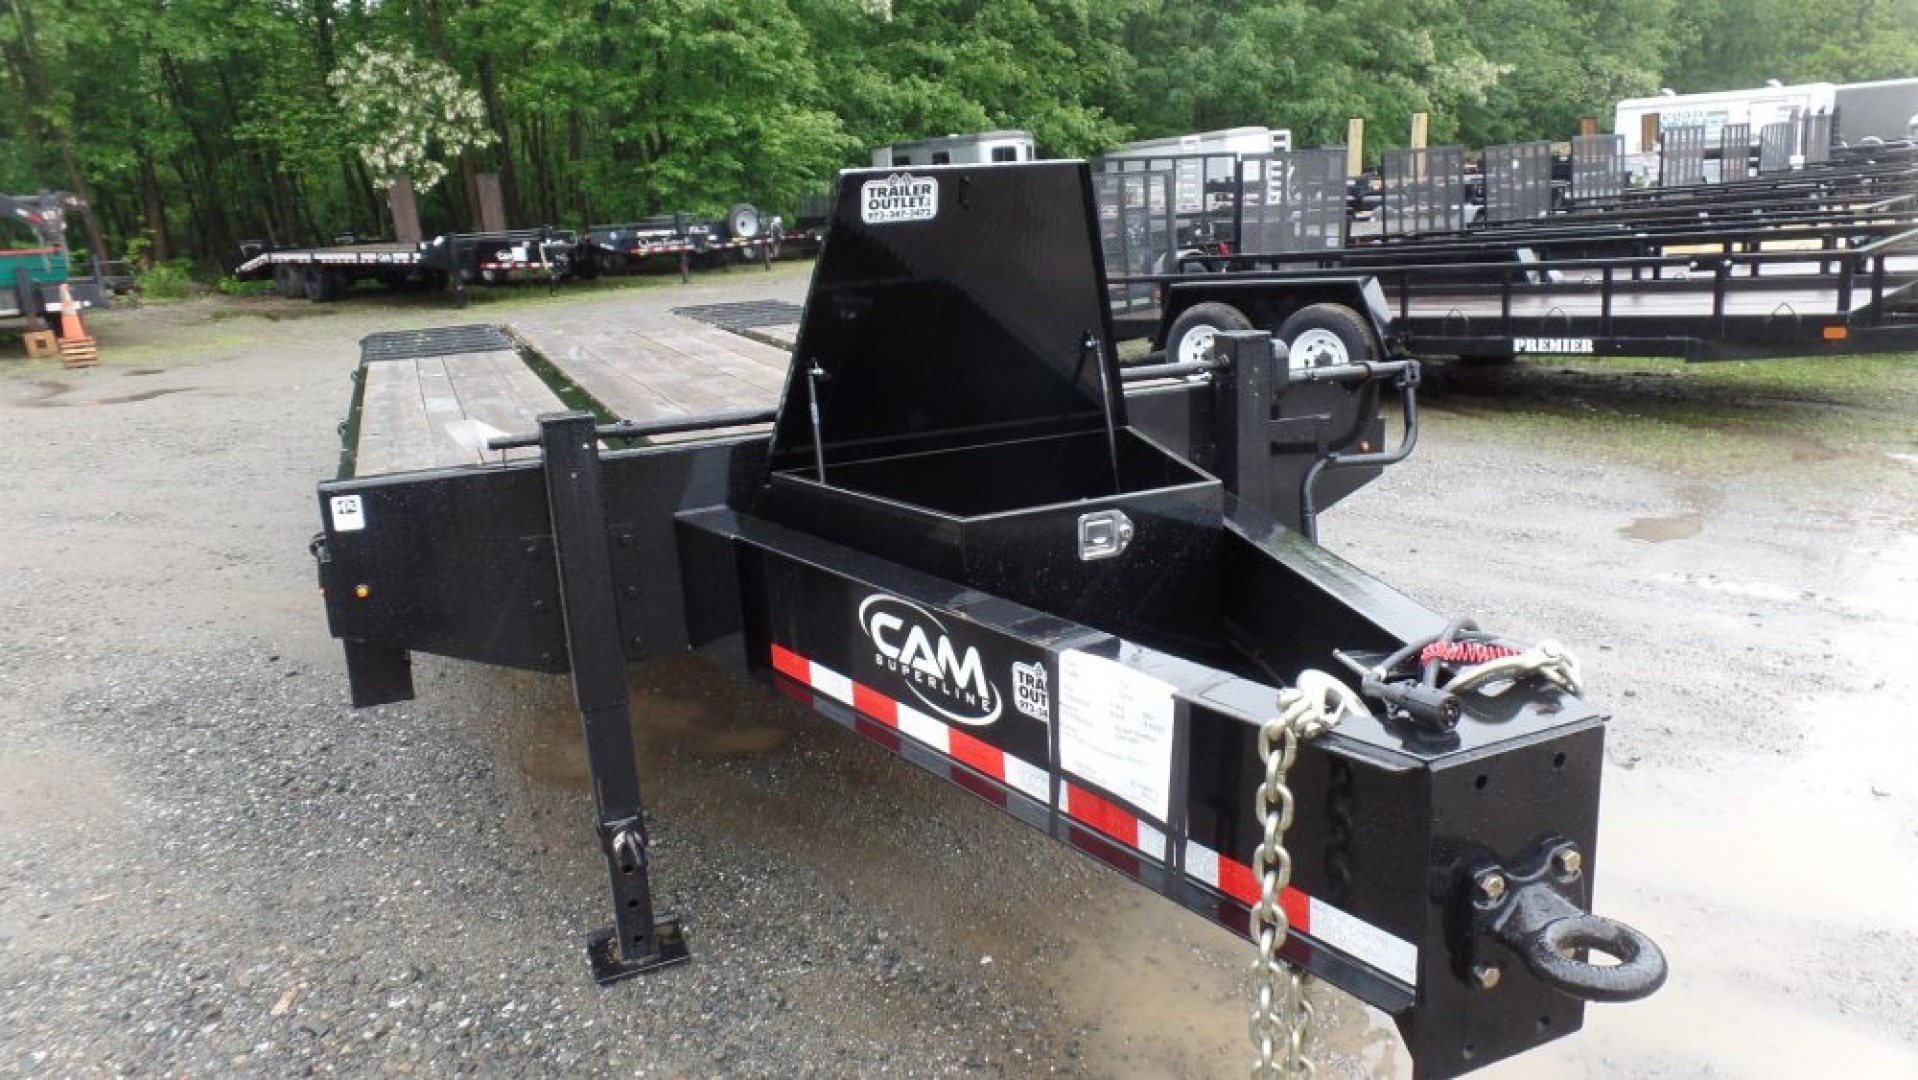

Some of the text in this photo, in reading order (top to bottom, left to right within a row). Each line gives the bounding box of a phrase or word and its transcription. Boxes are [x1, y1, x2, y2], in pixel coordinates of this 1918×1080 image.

[868, 184, 931, 198] TRAILER
[868, 195, 924, 210] OUTLET
[1513, 338, 1594, 353] PREMIER
[870, 612, 990, 700] CAM
[875, 652, 991, 712] SUPERLINE
[1018, 670, 1047, 692] TRA
